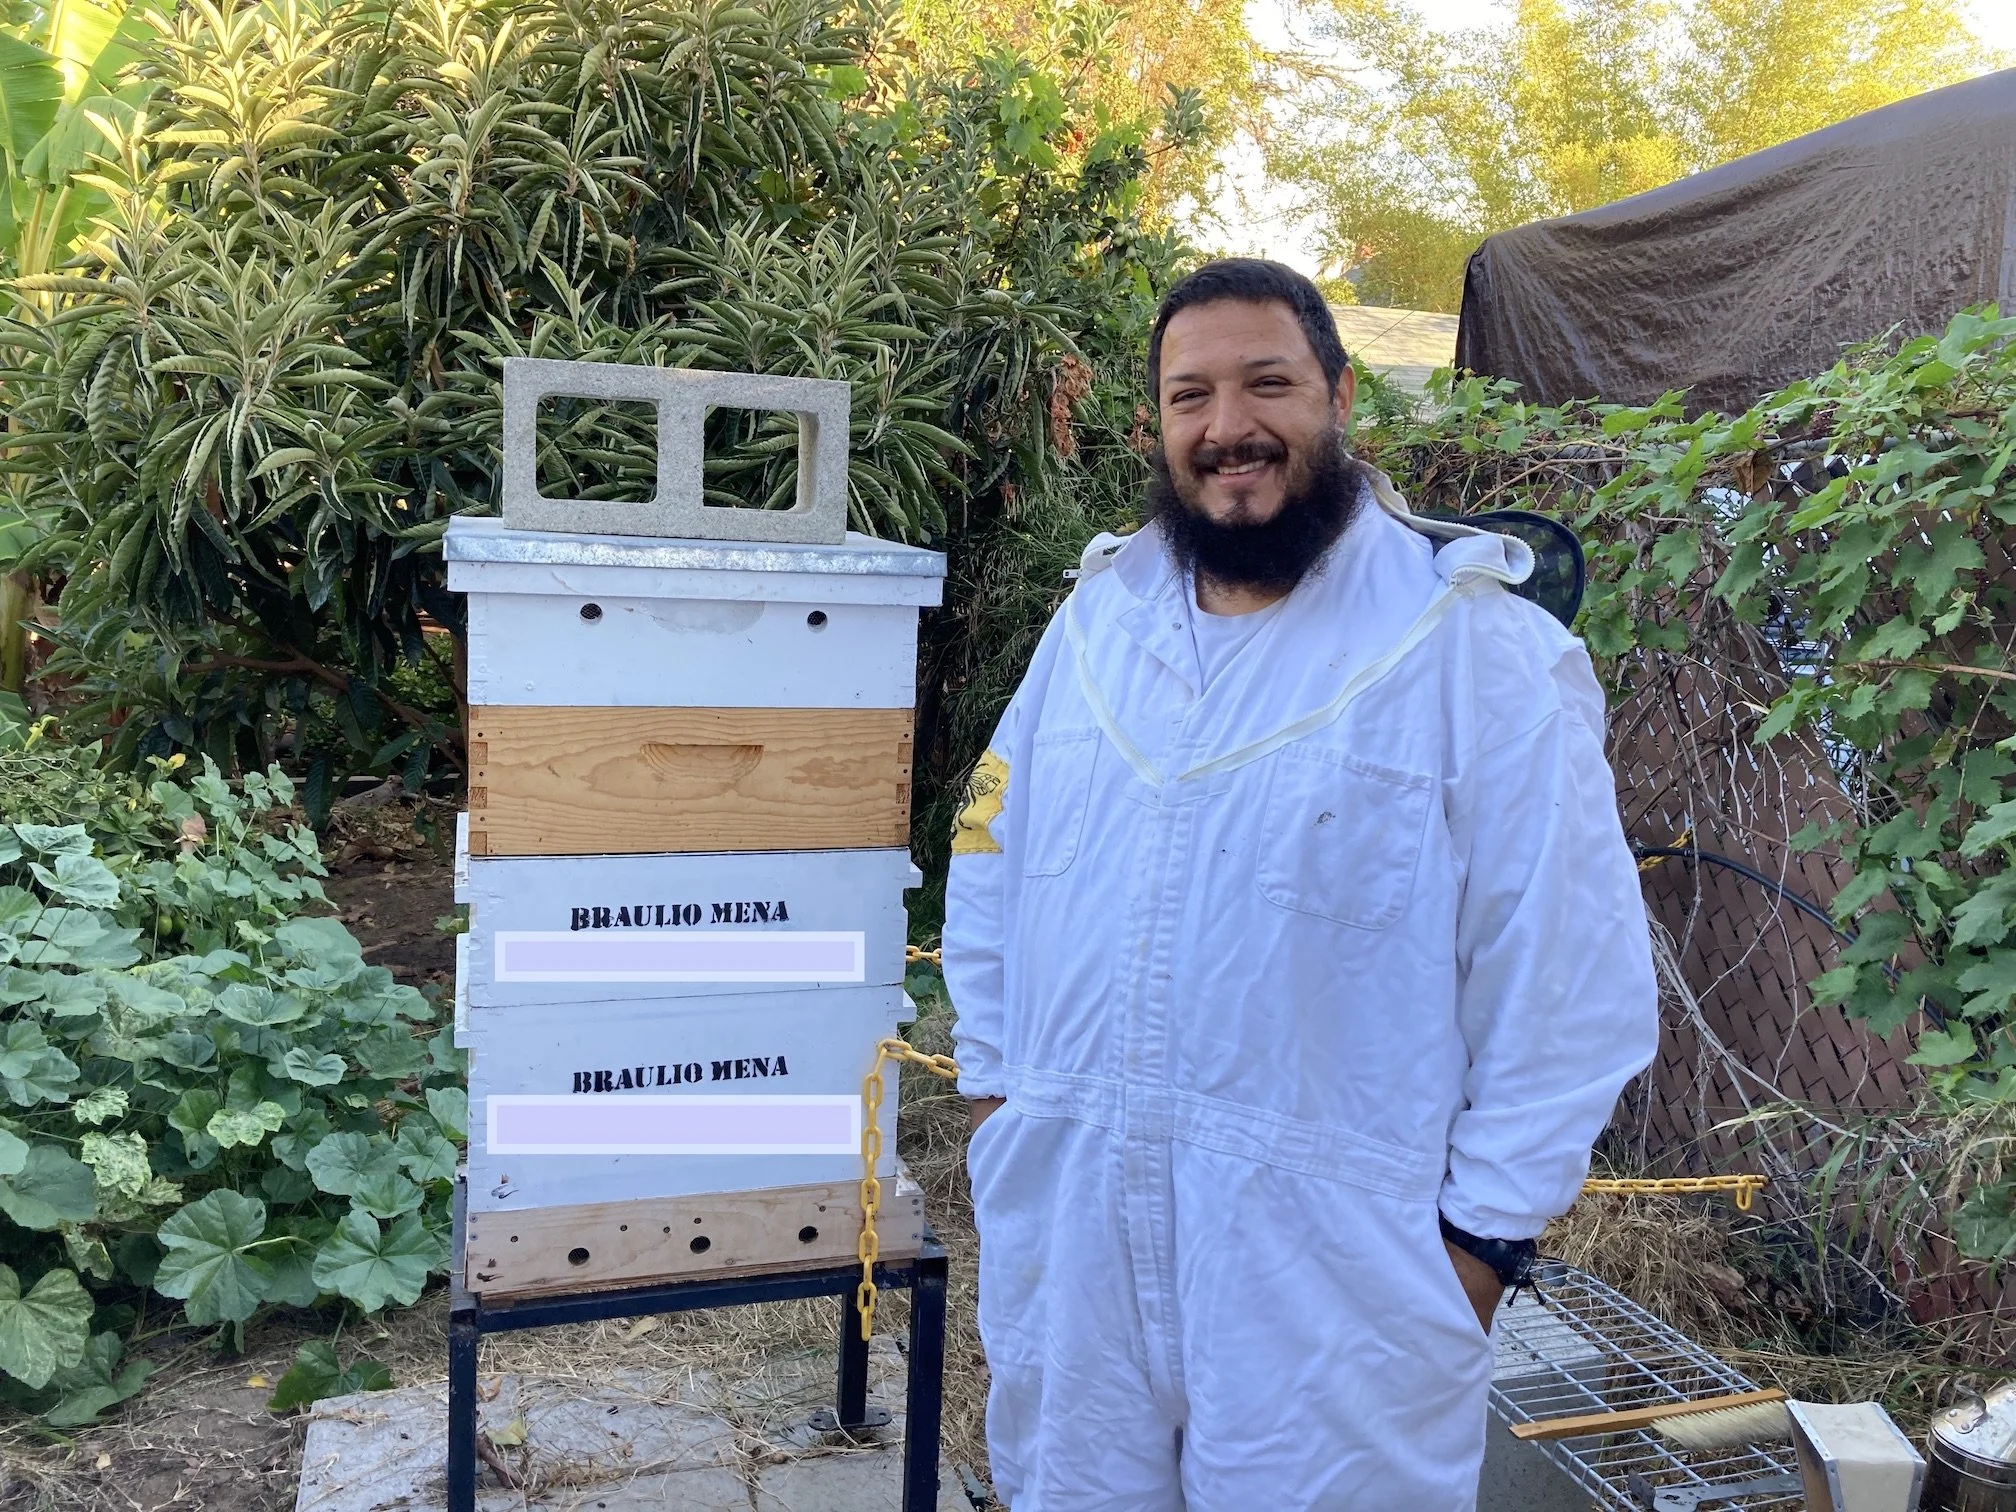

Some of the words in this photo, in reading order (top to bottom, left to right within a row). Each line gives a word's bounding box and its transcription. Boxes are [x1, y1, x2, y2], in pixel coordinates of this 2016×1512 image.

[570, 903, 702, 931] BRAULIO
[710, 900, 790, 924] MENA
[572, 1062, 703, 1093] BRAULIO
[711, 1055, 789, 1081] MENA
